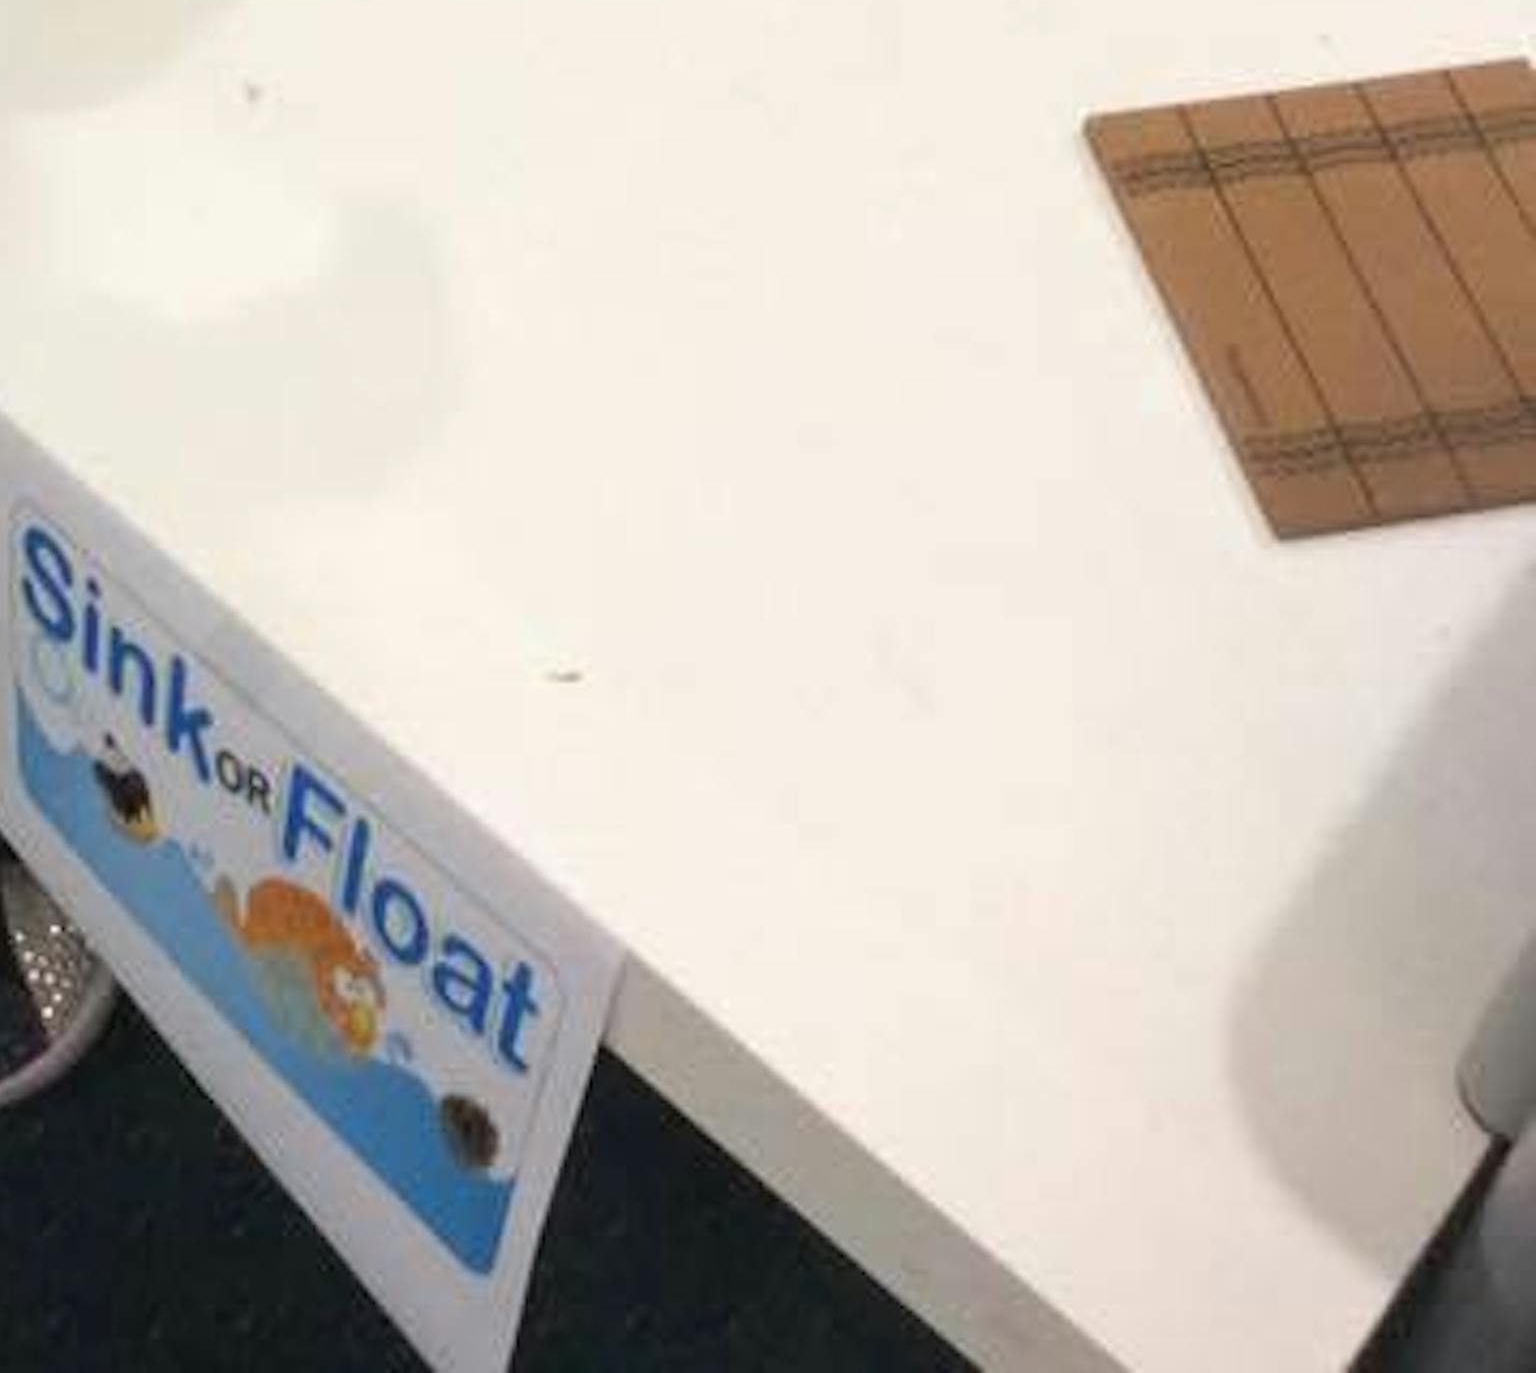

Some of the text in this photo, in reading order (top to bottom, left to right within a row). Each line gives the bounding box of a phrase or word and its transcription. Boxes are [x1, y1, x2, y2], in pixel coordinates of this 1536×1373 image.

[21, 526, 542, 1076] Sink OR Float
